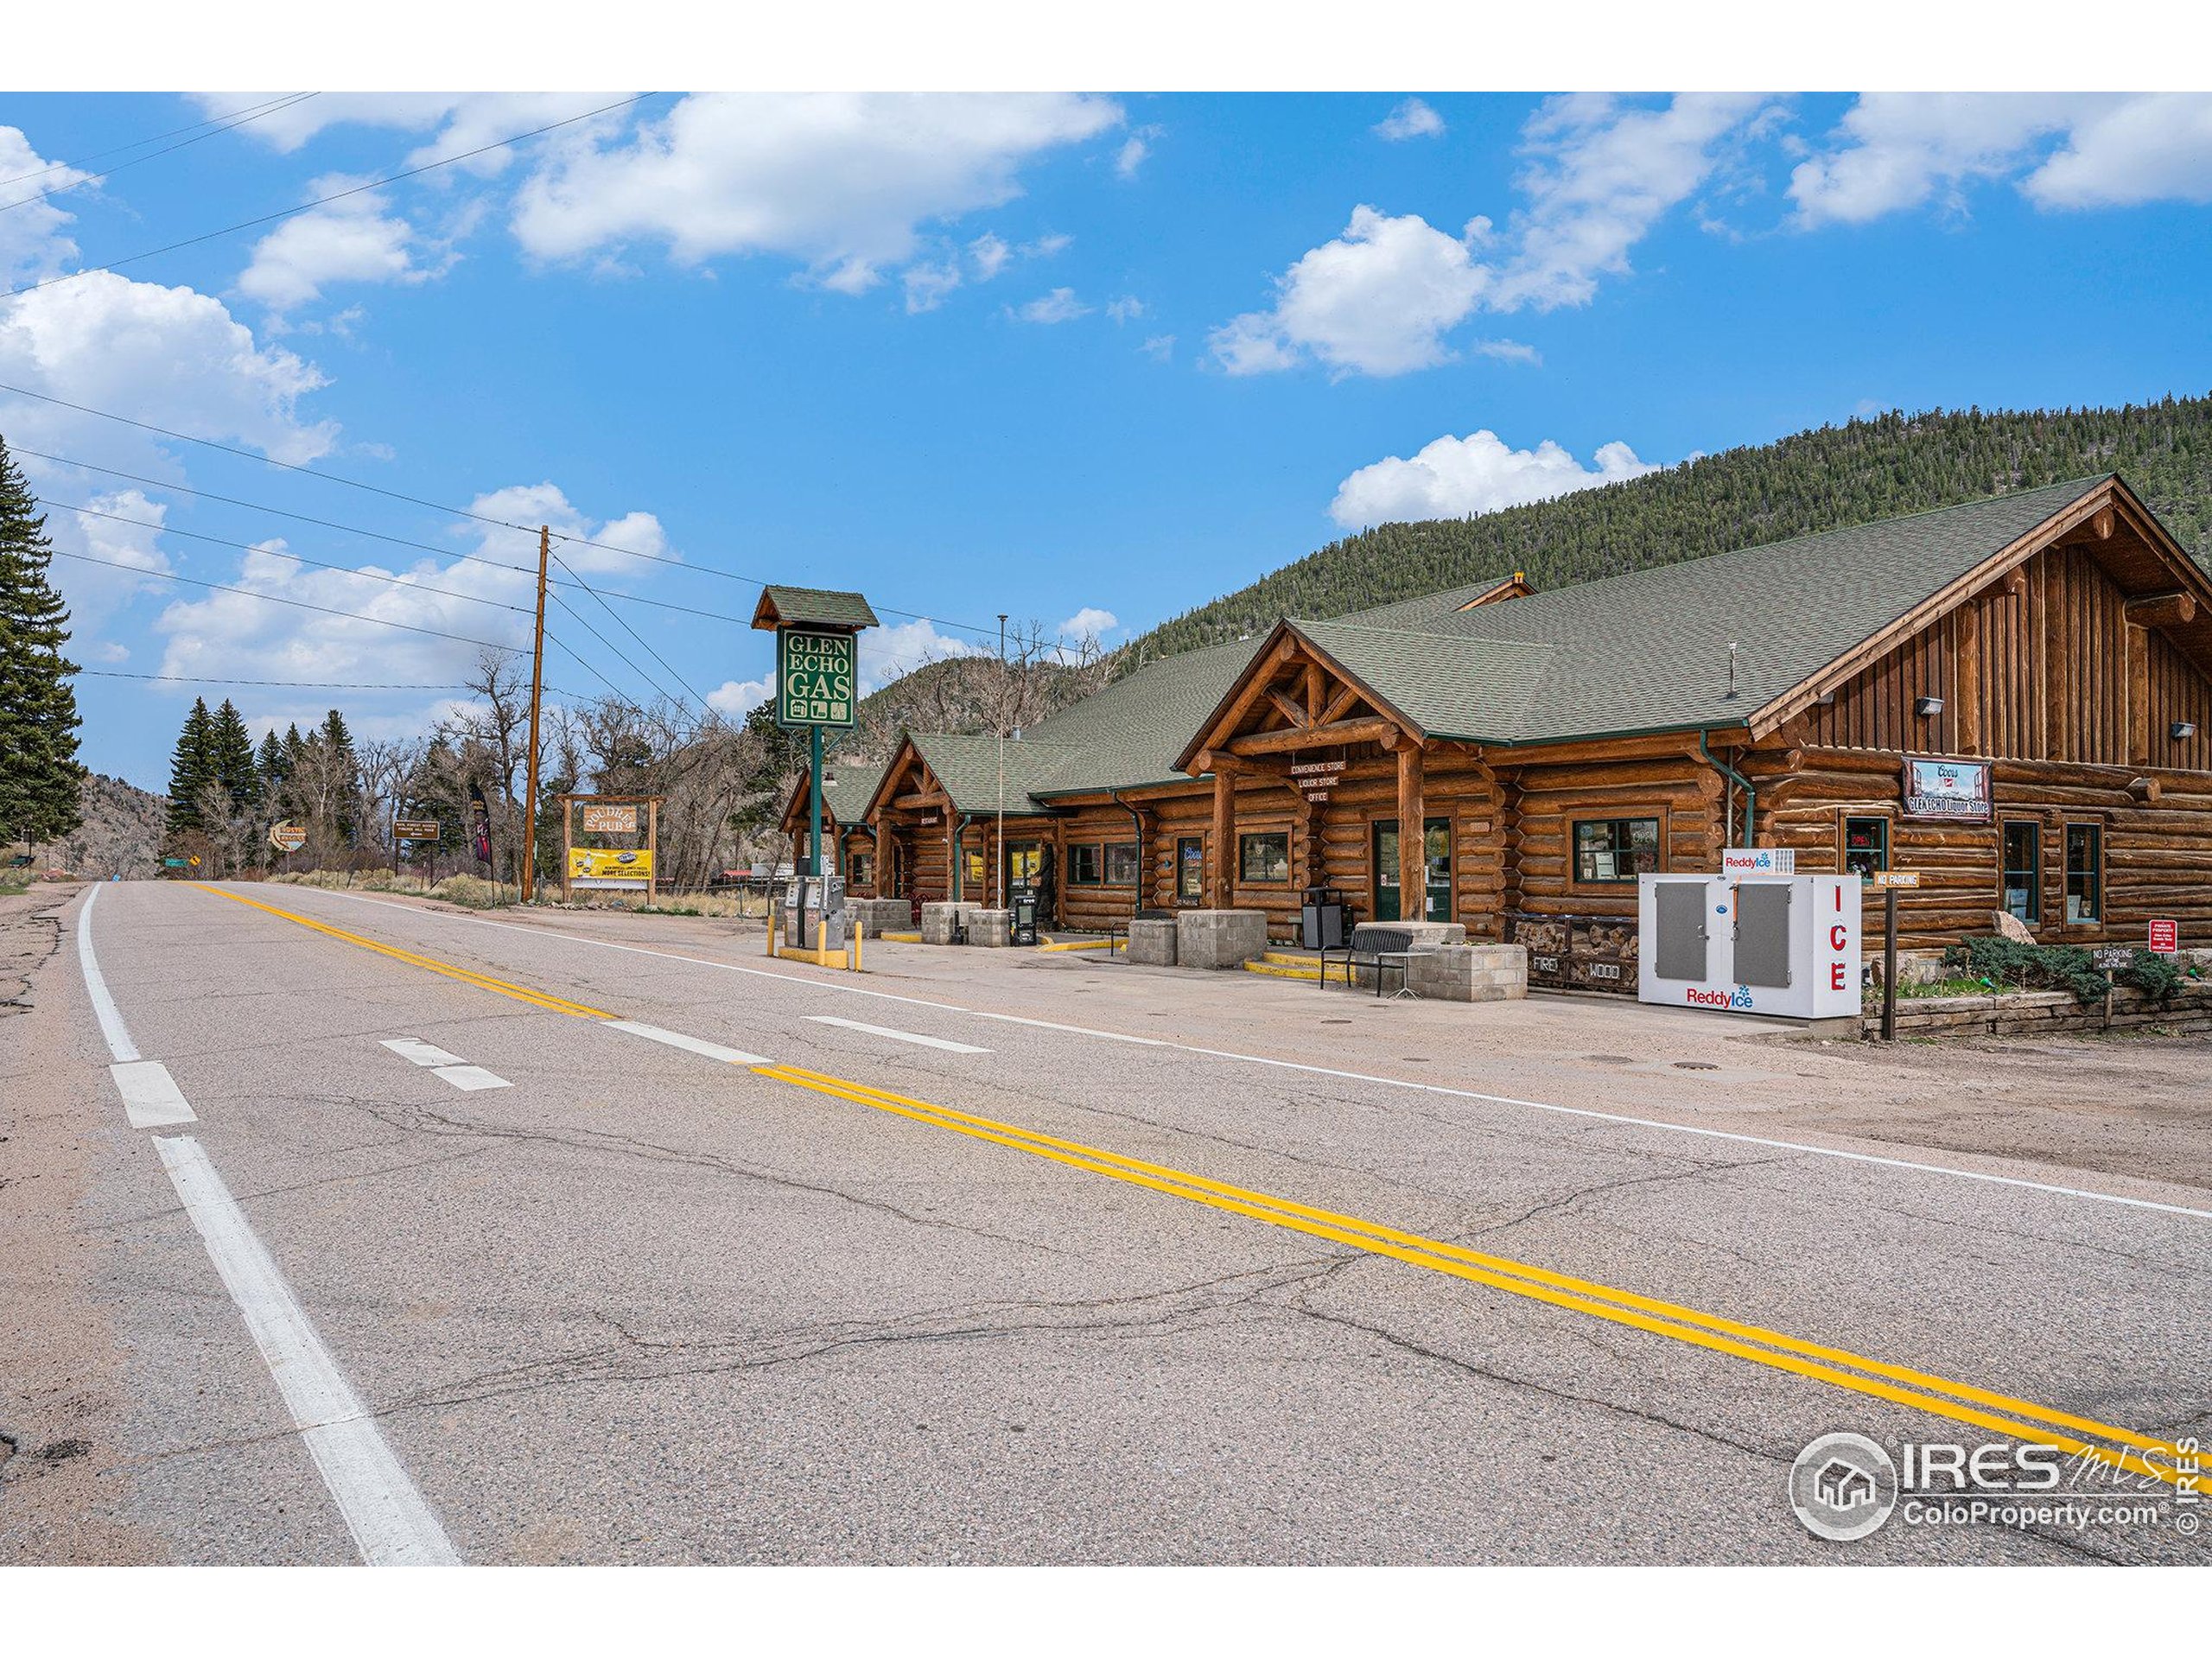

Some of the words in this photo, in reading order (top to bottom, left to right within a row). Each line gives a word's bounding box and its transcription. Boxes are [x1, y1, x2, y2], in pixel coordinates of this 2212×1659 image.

[788, 635, 849, 657] GLEN
[788, 653, 849, 674] ECHO
[787, 672, 850, 702] GAS
[1291, 764, 1325, 775] CONVENIENCE
[1326, 761, 1346, 772] STORE
[1937, 765, 1959, 778] Coors
[1298, 779, 1319, 788] LIQUOR
[1319, 776, 1338, 786] STORE
[1308, 792, 1328, 802] OFFICE
[1908, 797, 1928, 811] GLEN
[1928, 798, 1947, 811] ECHO
[599, 821, 623, 831] PUB
[1726, 853, 1770, 869] ReddyIce
[1878, 874, 1887, 886] NO
[1889, 874, 1917, 886] PARKING
[2093, 950, 2103, 959] NO
[2103, 949, 2133, 959] PARKING
[1534, 957, 1558, 972] FIRE
[1589, 963, 1620, 979] WOOD
[1687, 988, 1753, 1009] ReddyIce
